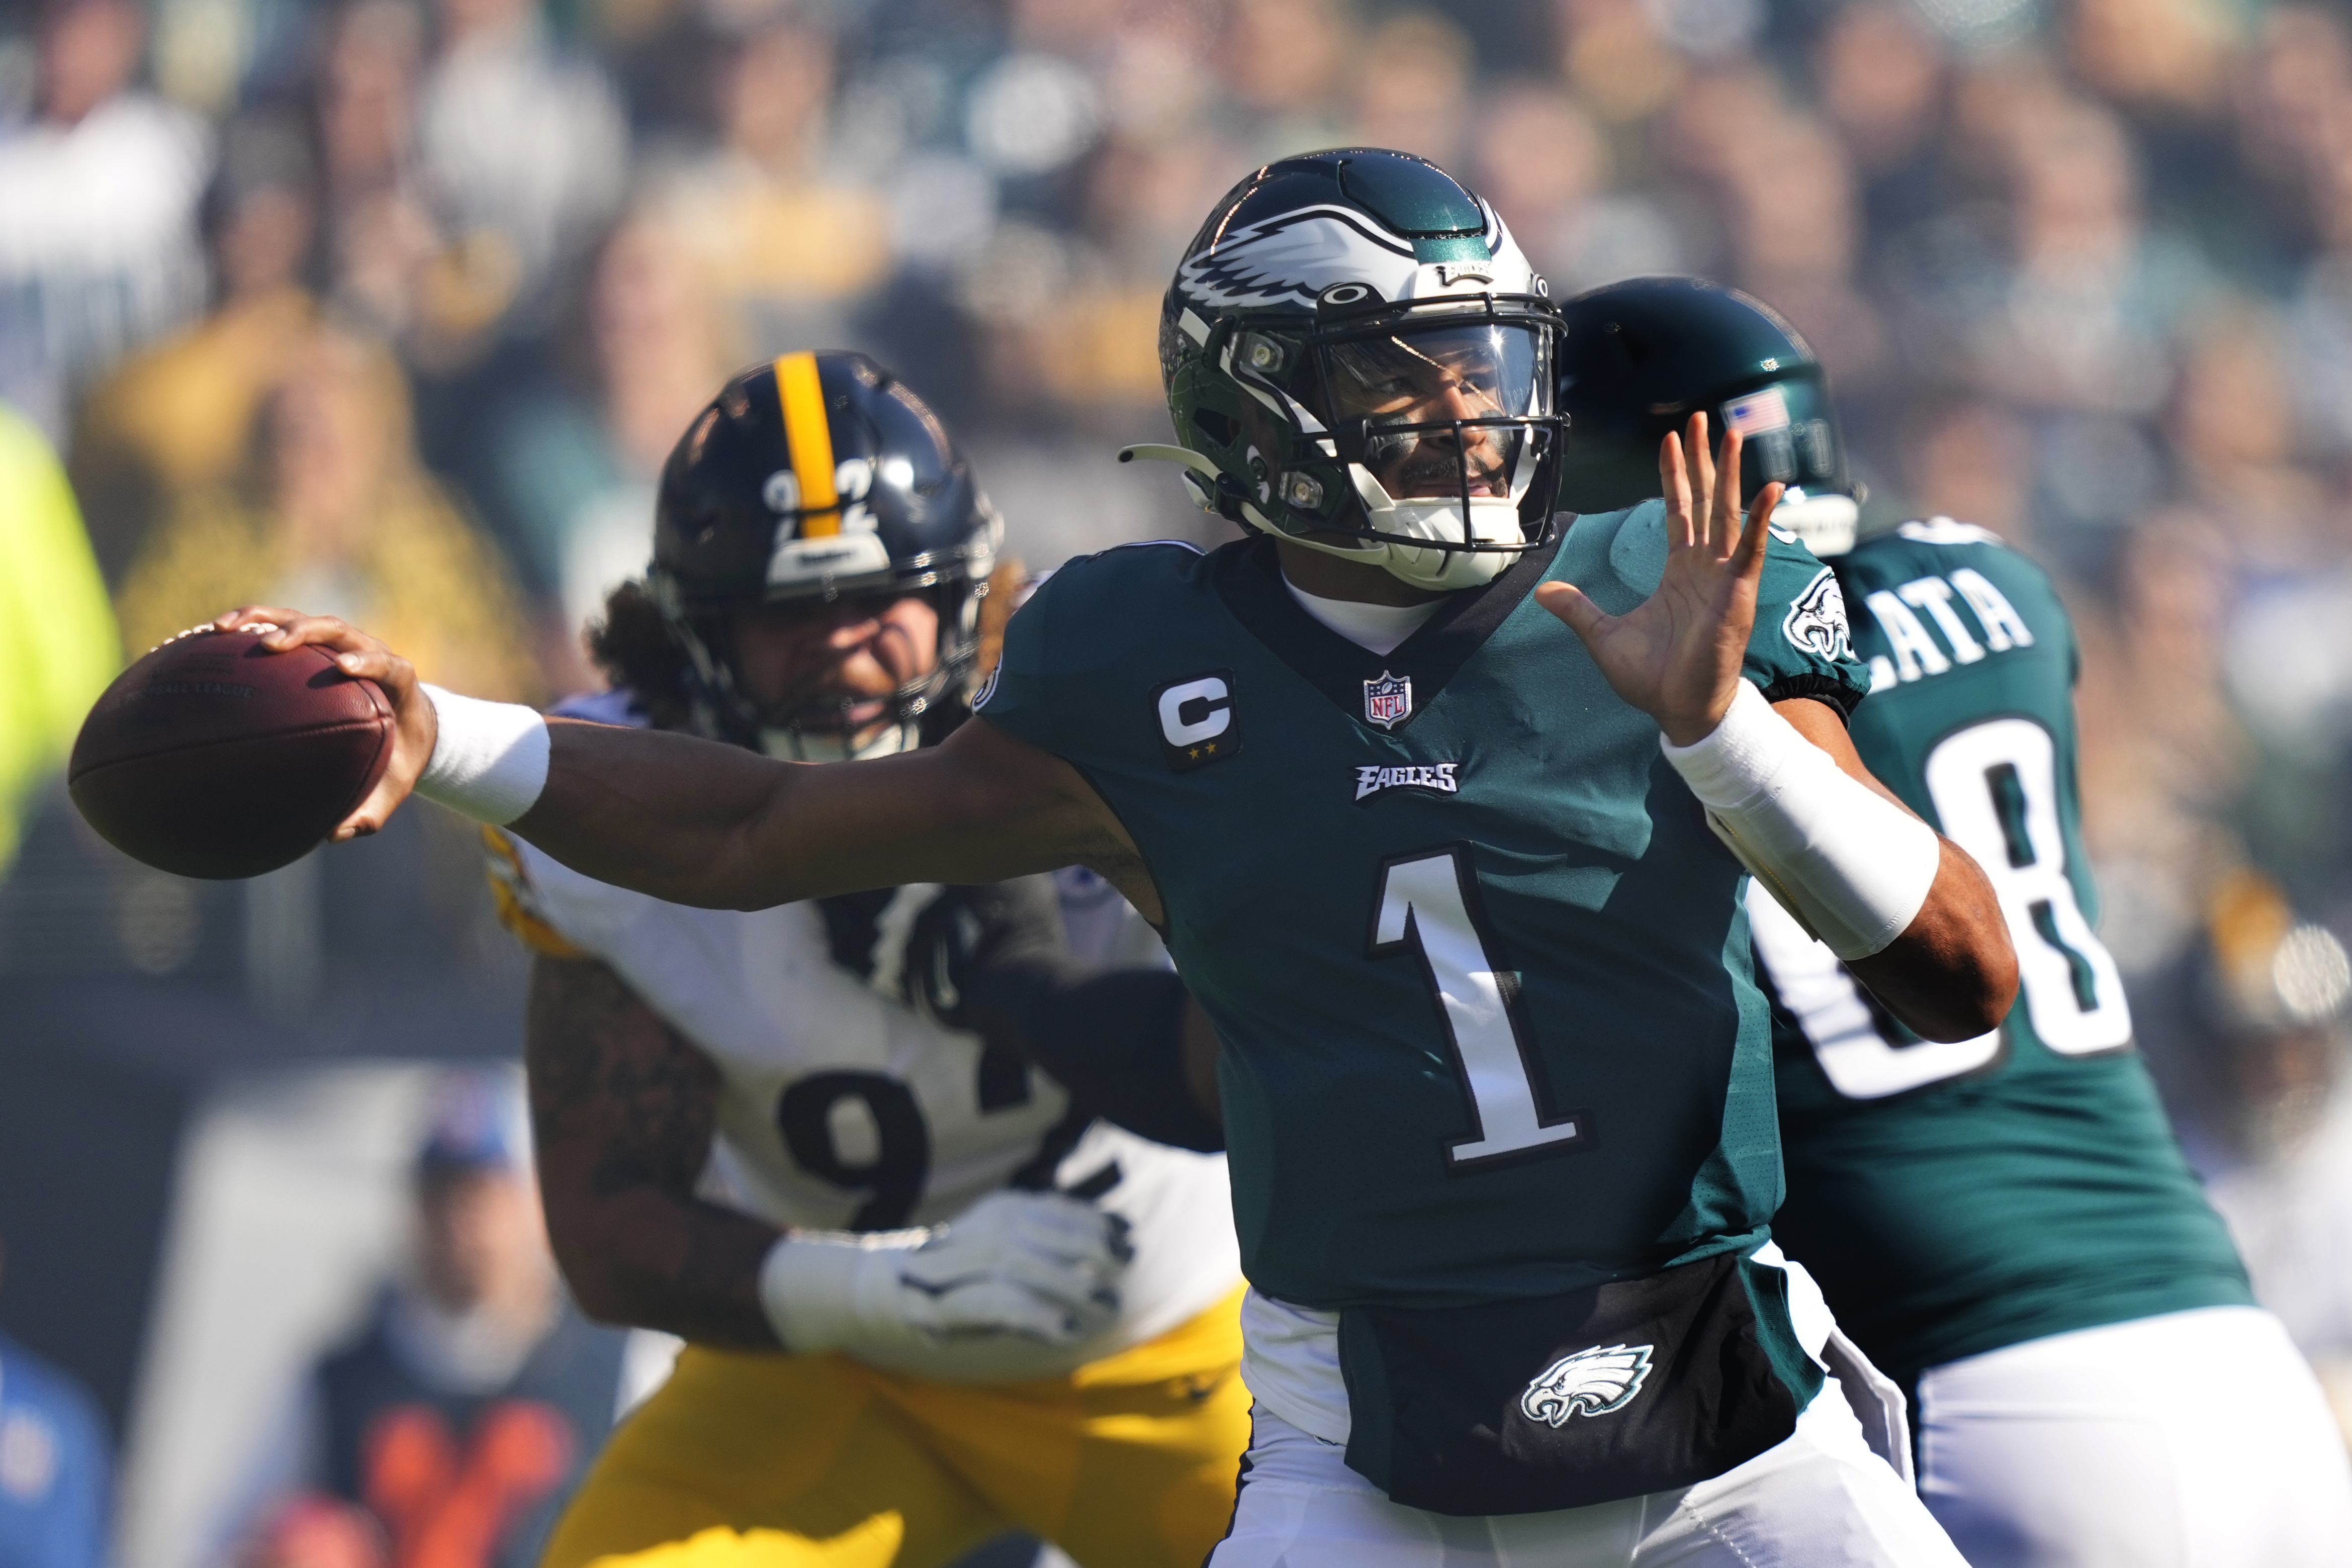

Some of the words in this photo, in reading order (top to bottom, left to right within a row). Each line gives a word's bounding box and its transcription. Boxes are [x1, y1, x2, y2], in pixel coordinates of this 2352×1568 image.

[763, 458, 879, 548] 92
[1158, 677, 1231, 747] C
[1372, 695, 1404, 717] NFL
[1354, 763, 1459, 801] EAGLES
[1375, 853, 1577, 1162] 1
